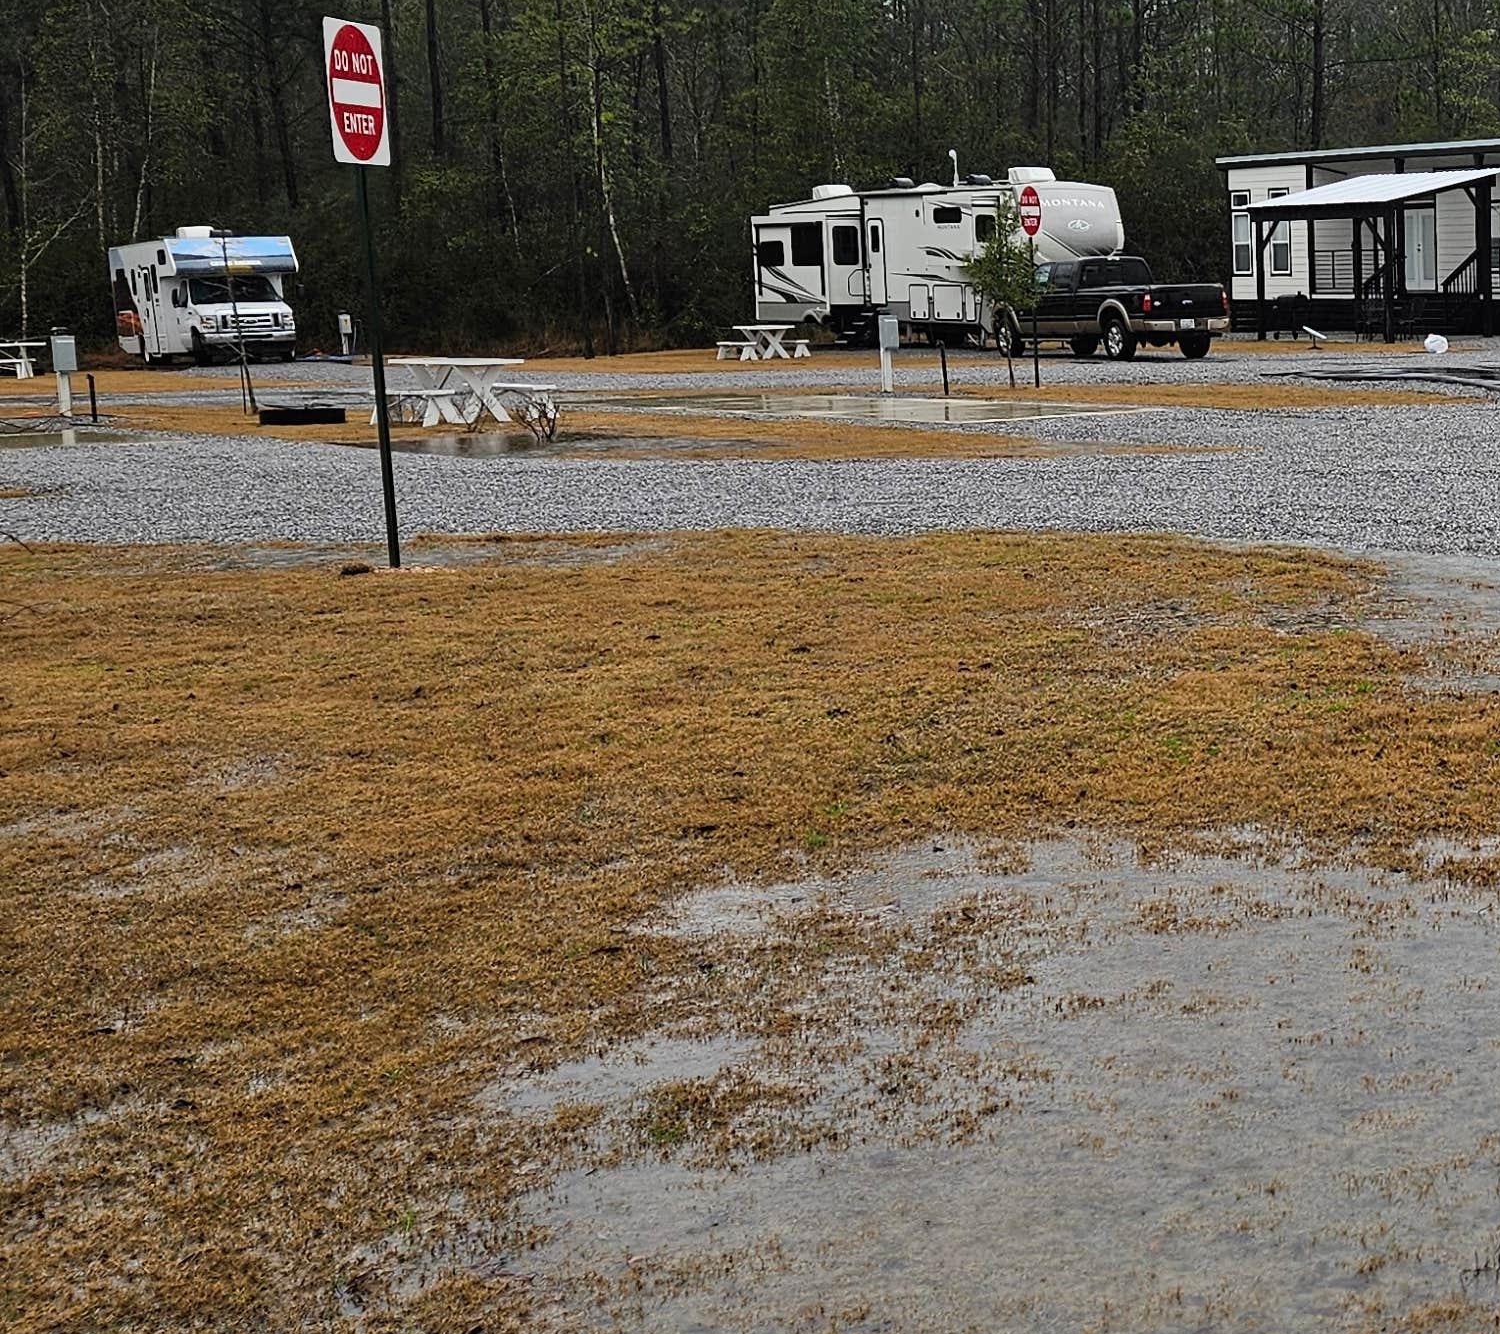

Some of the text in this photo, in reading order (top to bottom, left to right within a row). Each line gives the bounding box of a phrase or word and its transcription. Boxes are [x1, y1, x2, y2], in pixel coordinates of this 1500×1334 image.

[333, 49, 374, 76] DO NOT
[343, 112, 376, 136] ENTER
[1041, 199, 1105, 208] MONTANA
